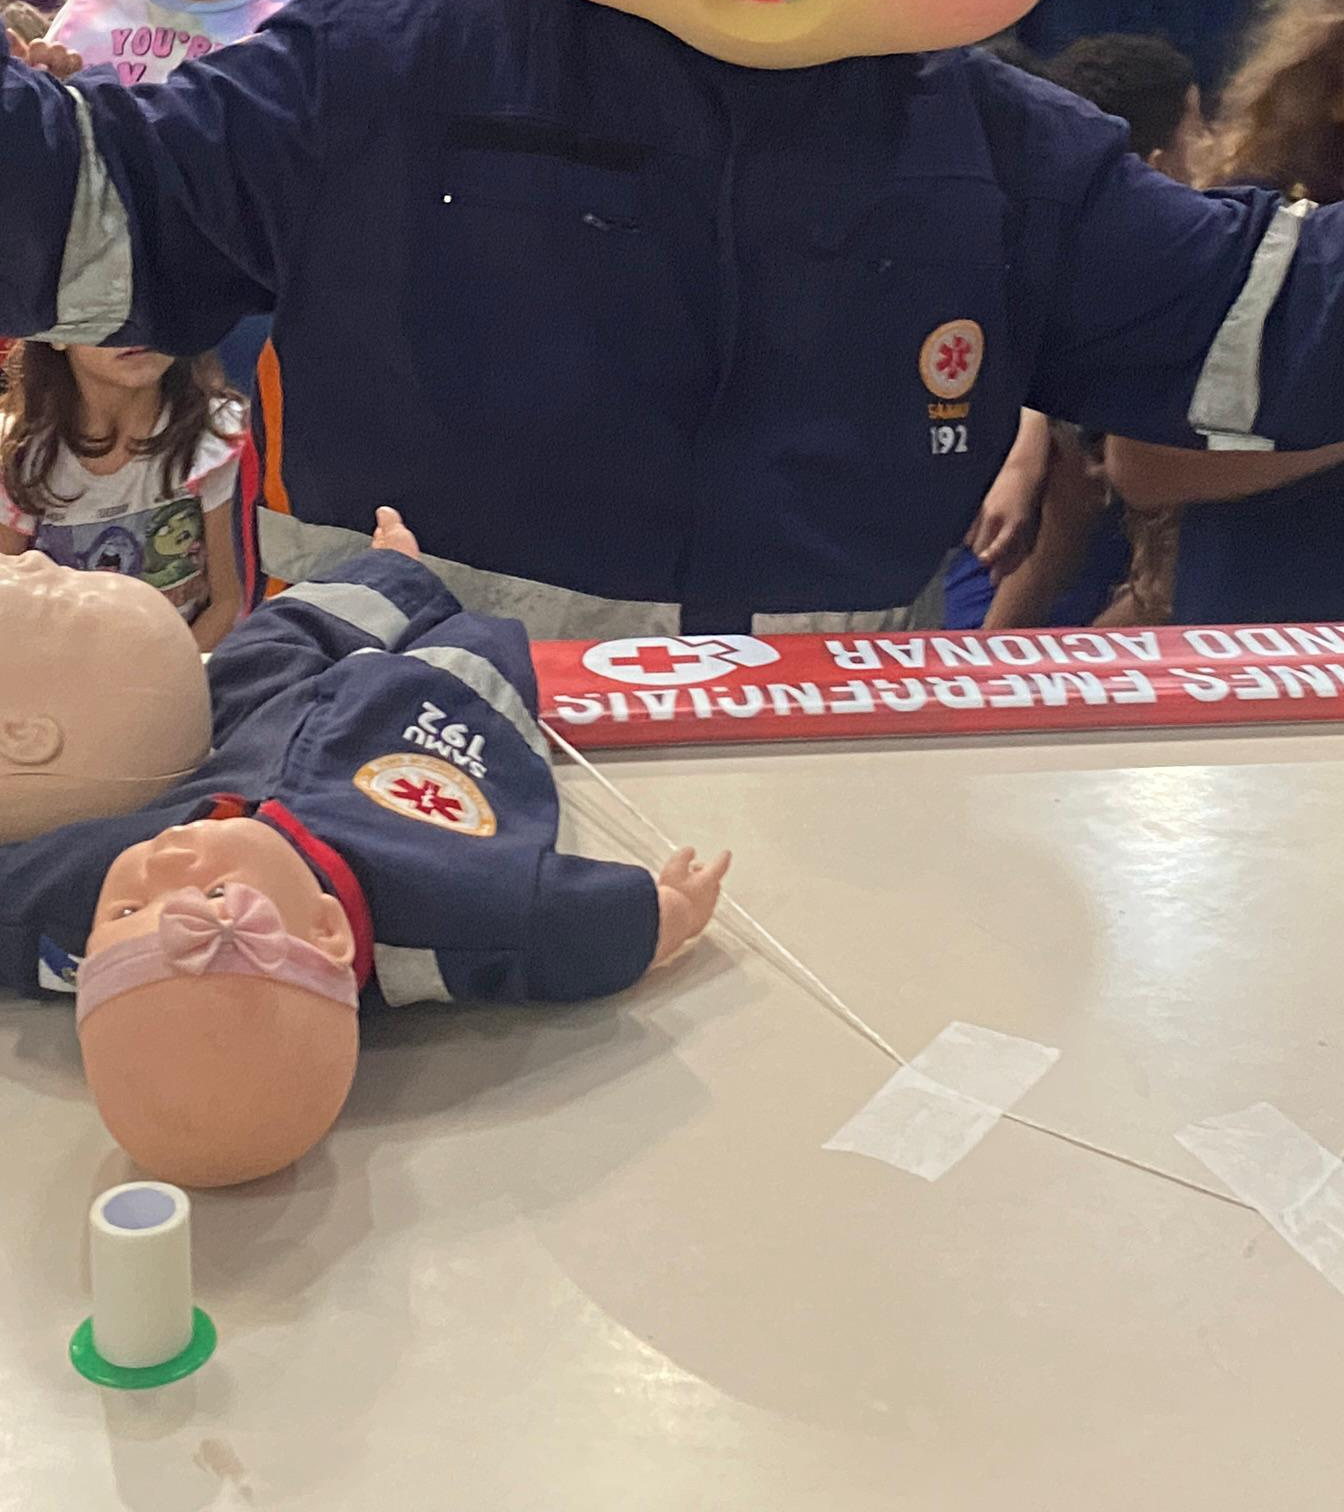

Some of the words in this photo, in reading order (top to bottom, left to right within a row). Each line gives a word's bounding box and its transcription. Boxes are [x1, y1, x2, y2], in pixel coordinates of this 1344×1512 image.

[111, 26, 225, 61] YOU'R
[929, 425, 969, 455] 192
[825, 631, 1162, 670] ACIONAR
[418, 701, 486, 762] 192
[402, 725, 488, 778] SAMU
